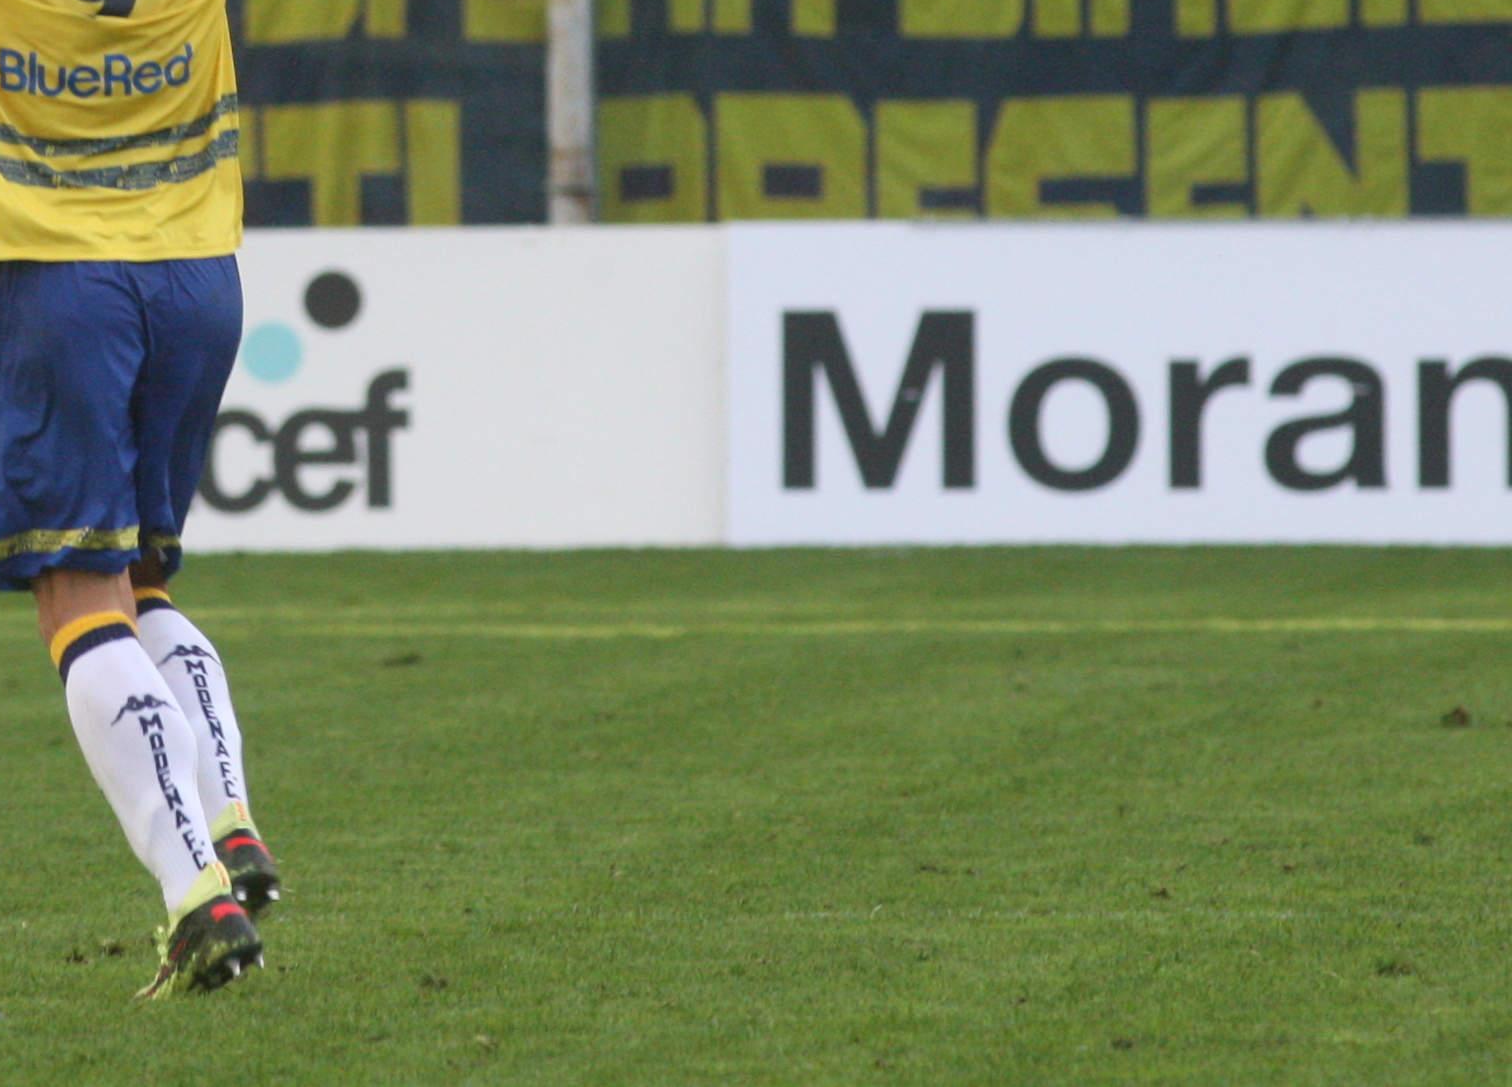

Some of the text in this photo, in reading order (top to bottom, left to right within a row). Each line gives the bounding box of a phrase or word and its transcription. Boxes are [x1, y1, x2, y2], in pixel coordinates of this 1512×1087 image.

[780, 307, 1512, 492] Moran
[184, 659, 232, 758] MODENA
[138, 712, 191, 831] MODENA
